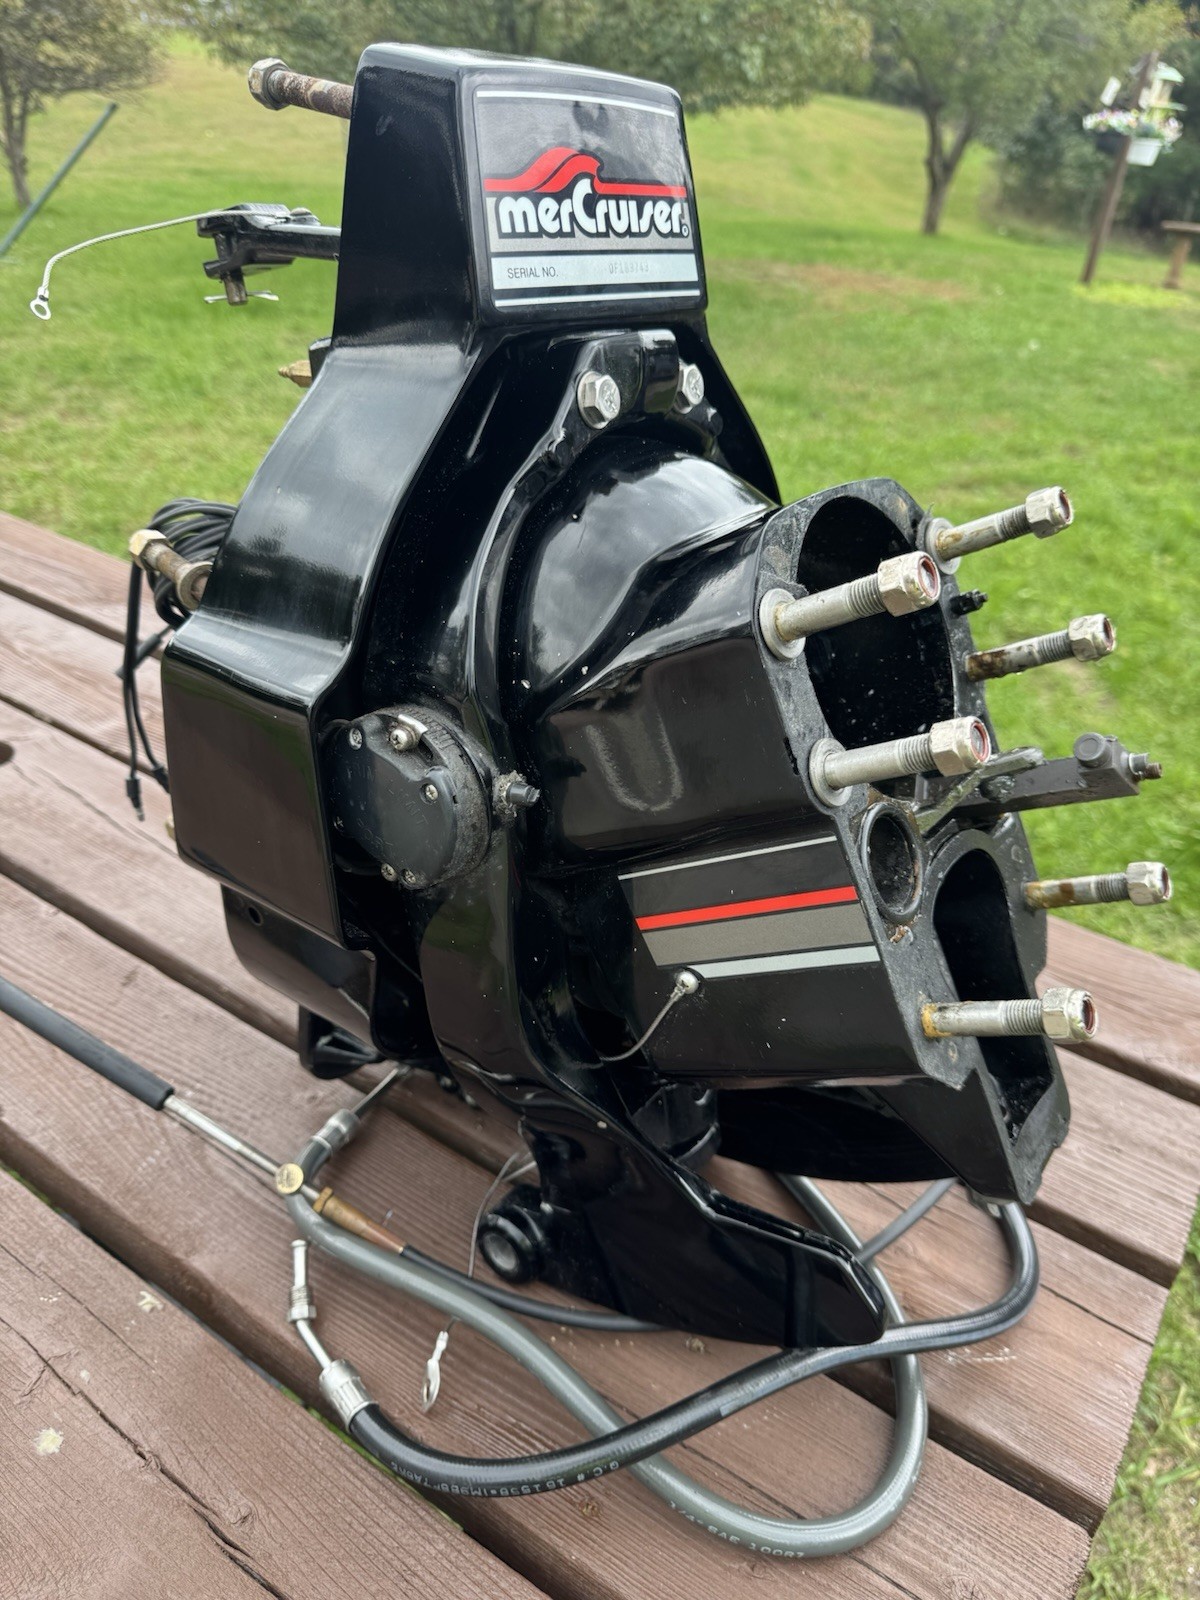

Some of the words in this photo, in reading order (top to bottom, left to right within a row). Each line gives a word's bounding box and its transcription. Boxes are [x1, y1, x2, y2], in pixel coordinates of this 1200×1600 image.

[507, 266, 540, 279] SERIAL
[542, 265, 559, 278] NO.
[708, 1525, 740, 1544] SAE
